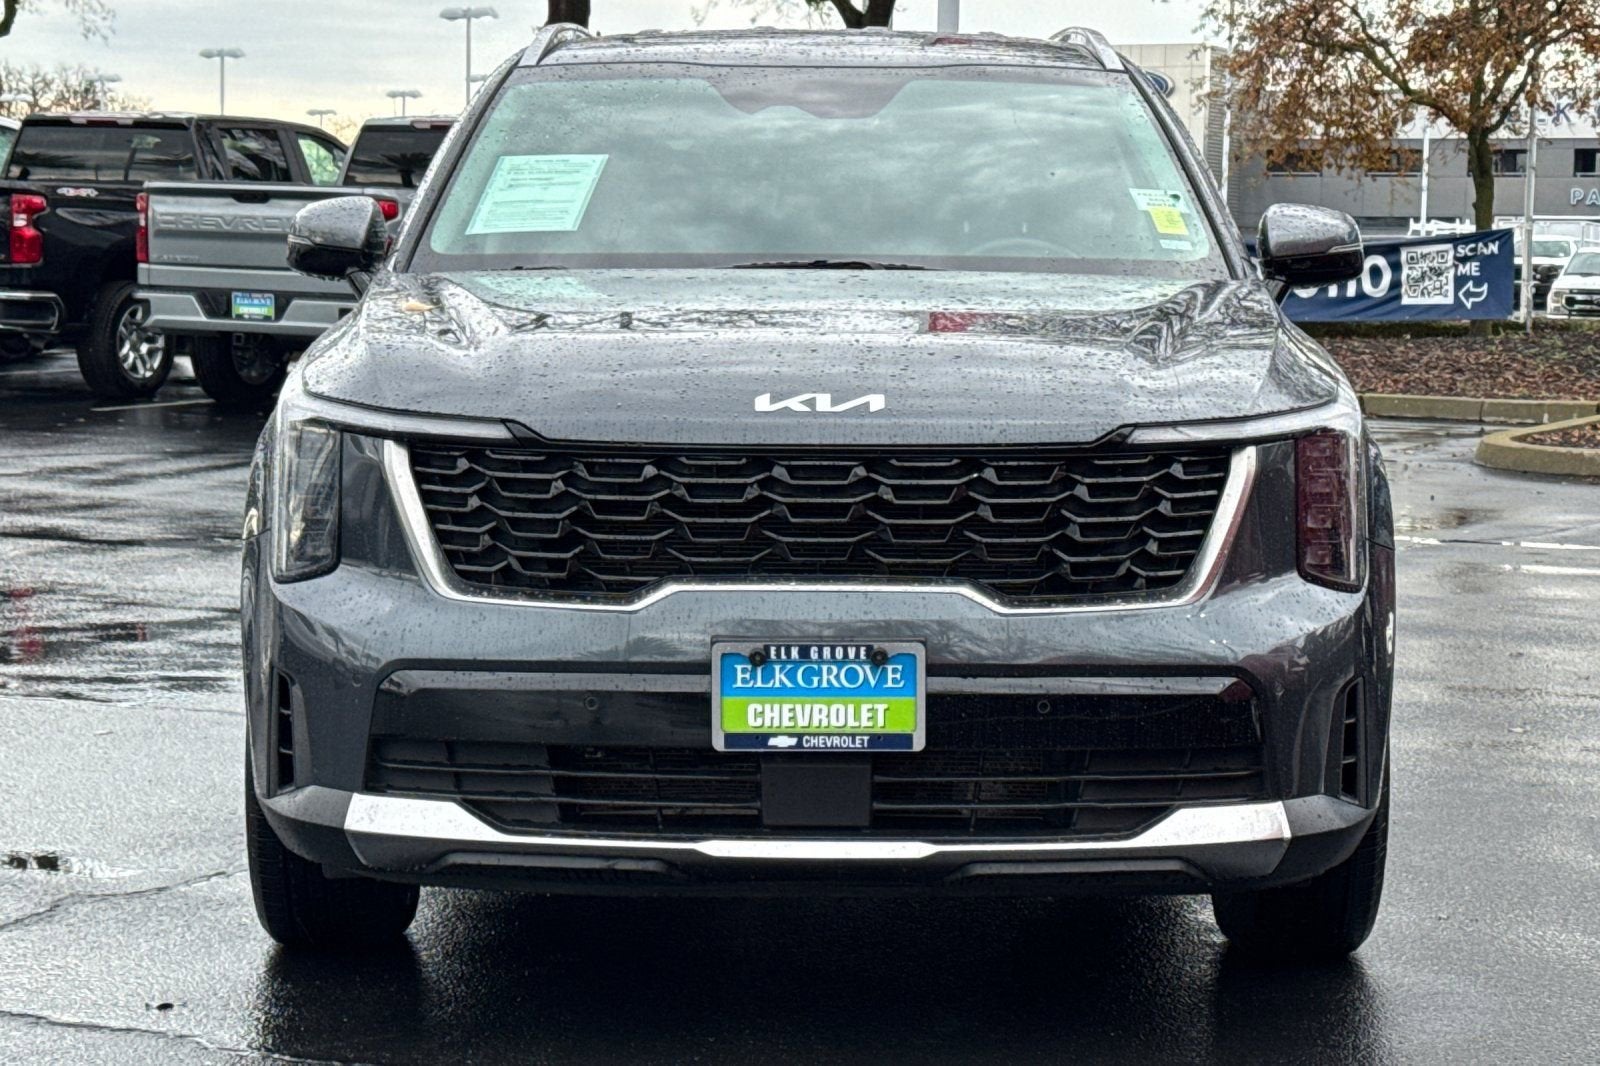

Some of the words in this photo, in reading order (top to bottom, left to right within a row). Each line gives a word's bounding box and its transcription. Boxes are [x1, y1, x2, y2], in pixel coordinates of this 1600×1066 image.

[1456, 241, 1499, 257] SCAN
[1456, 262, 1481, 277] ME
[770, 646, 799, 660] ELK
[810, 646, 867, 660] GROVE
[747, 703, 889, 728] CHEVROLET
[802, 735, 870, 748] CHEVROLET
